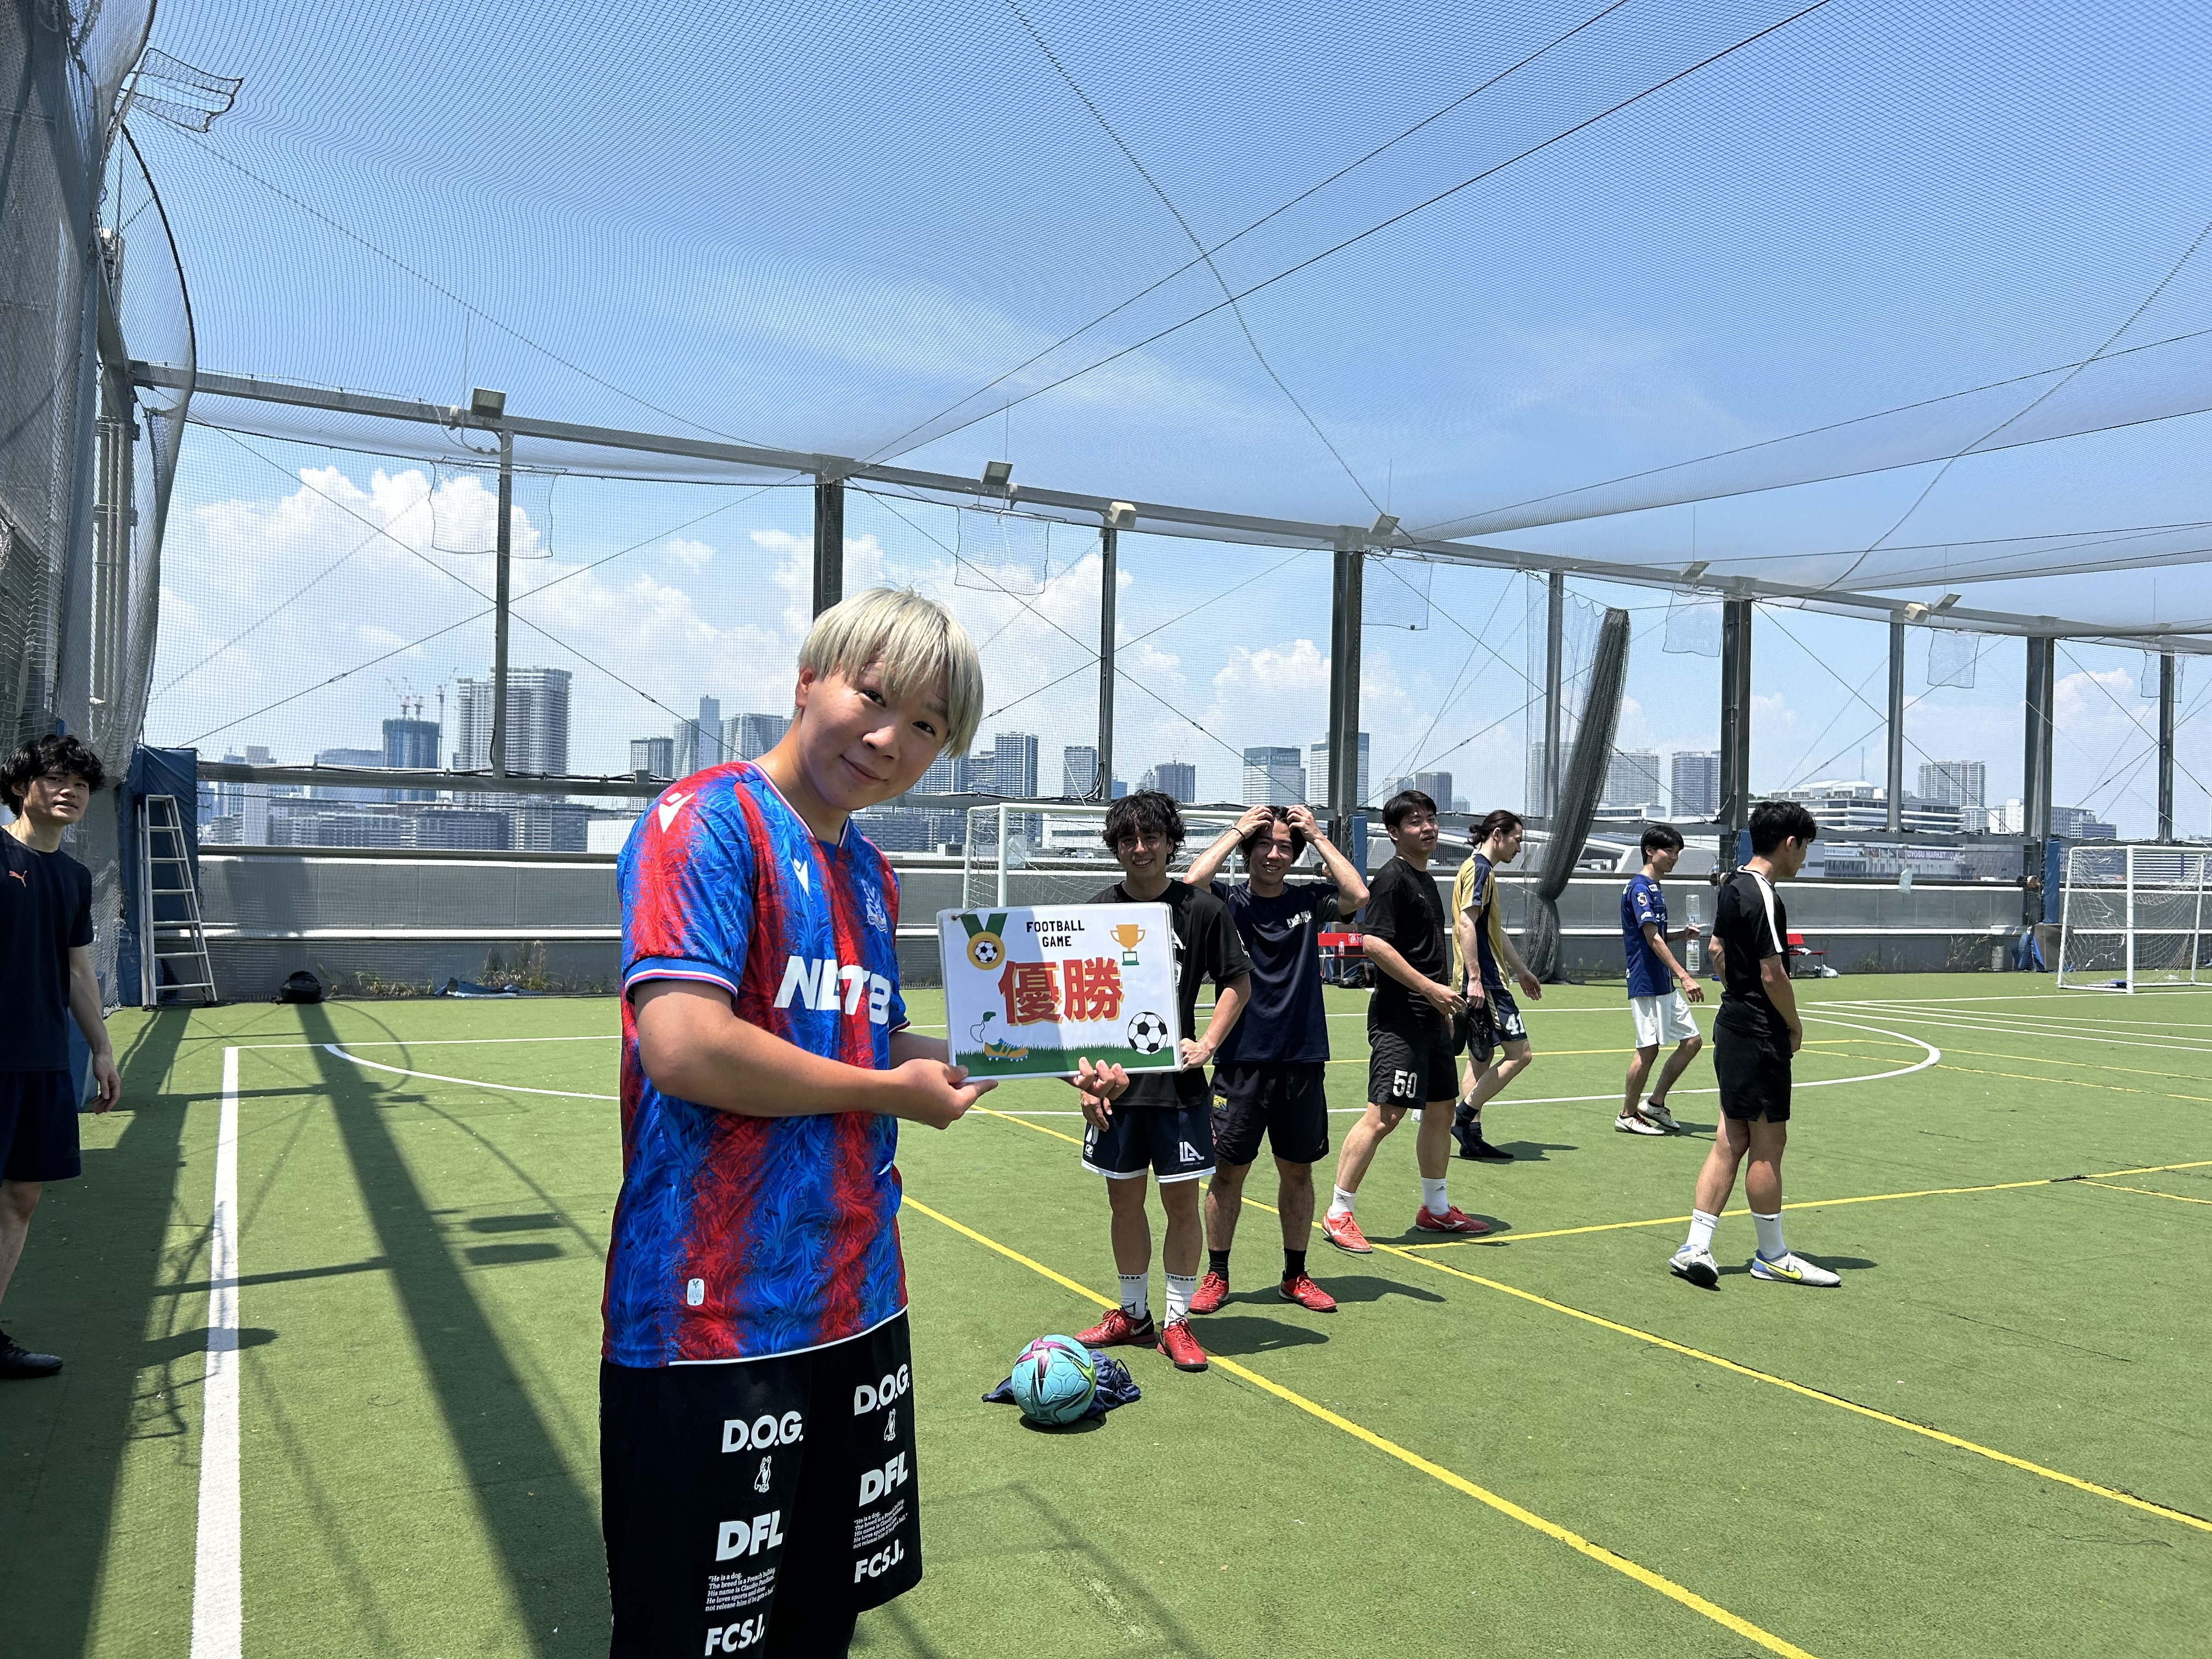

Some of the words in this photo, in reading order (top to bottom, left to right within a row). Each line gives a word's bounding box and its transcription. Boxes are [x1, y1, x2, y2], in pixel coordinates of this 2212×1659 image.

[1026, 920, 1085, 932] FOOTBALL
[1042, 935, 1071, 947] GAME
[998, 957, 1124, 1026] 優勝
[1505, 1013, 1525, 1035] 41
[1393, 1070, 1417, 1098] 50
[854, 1363, 910, 1415] D.O.G.
[722, 1410, 804, 1453] D.O.G.
[859, 1451, 908, 1506] DFL
[715, 1510, 783, 1561] DFL
[721, 1579, 737, 1588] breed
[716, 1602, 736, 1610] release
[731, 1593, 748, 1601] sports
